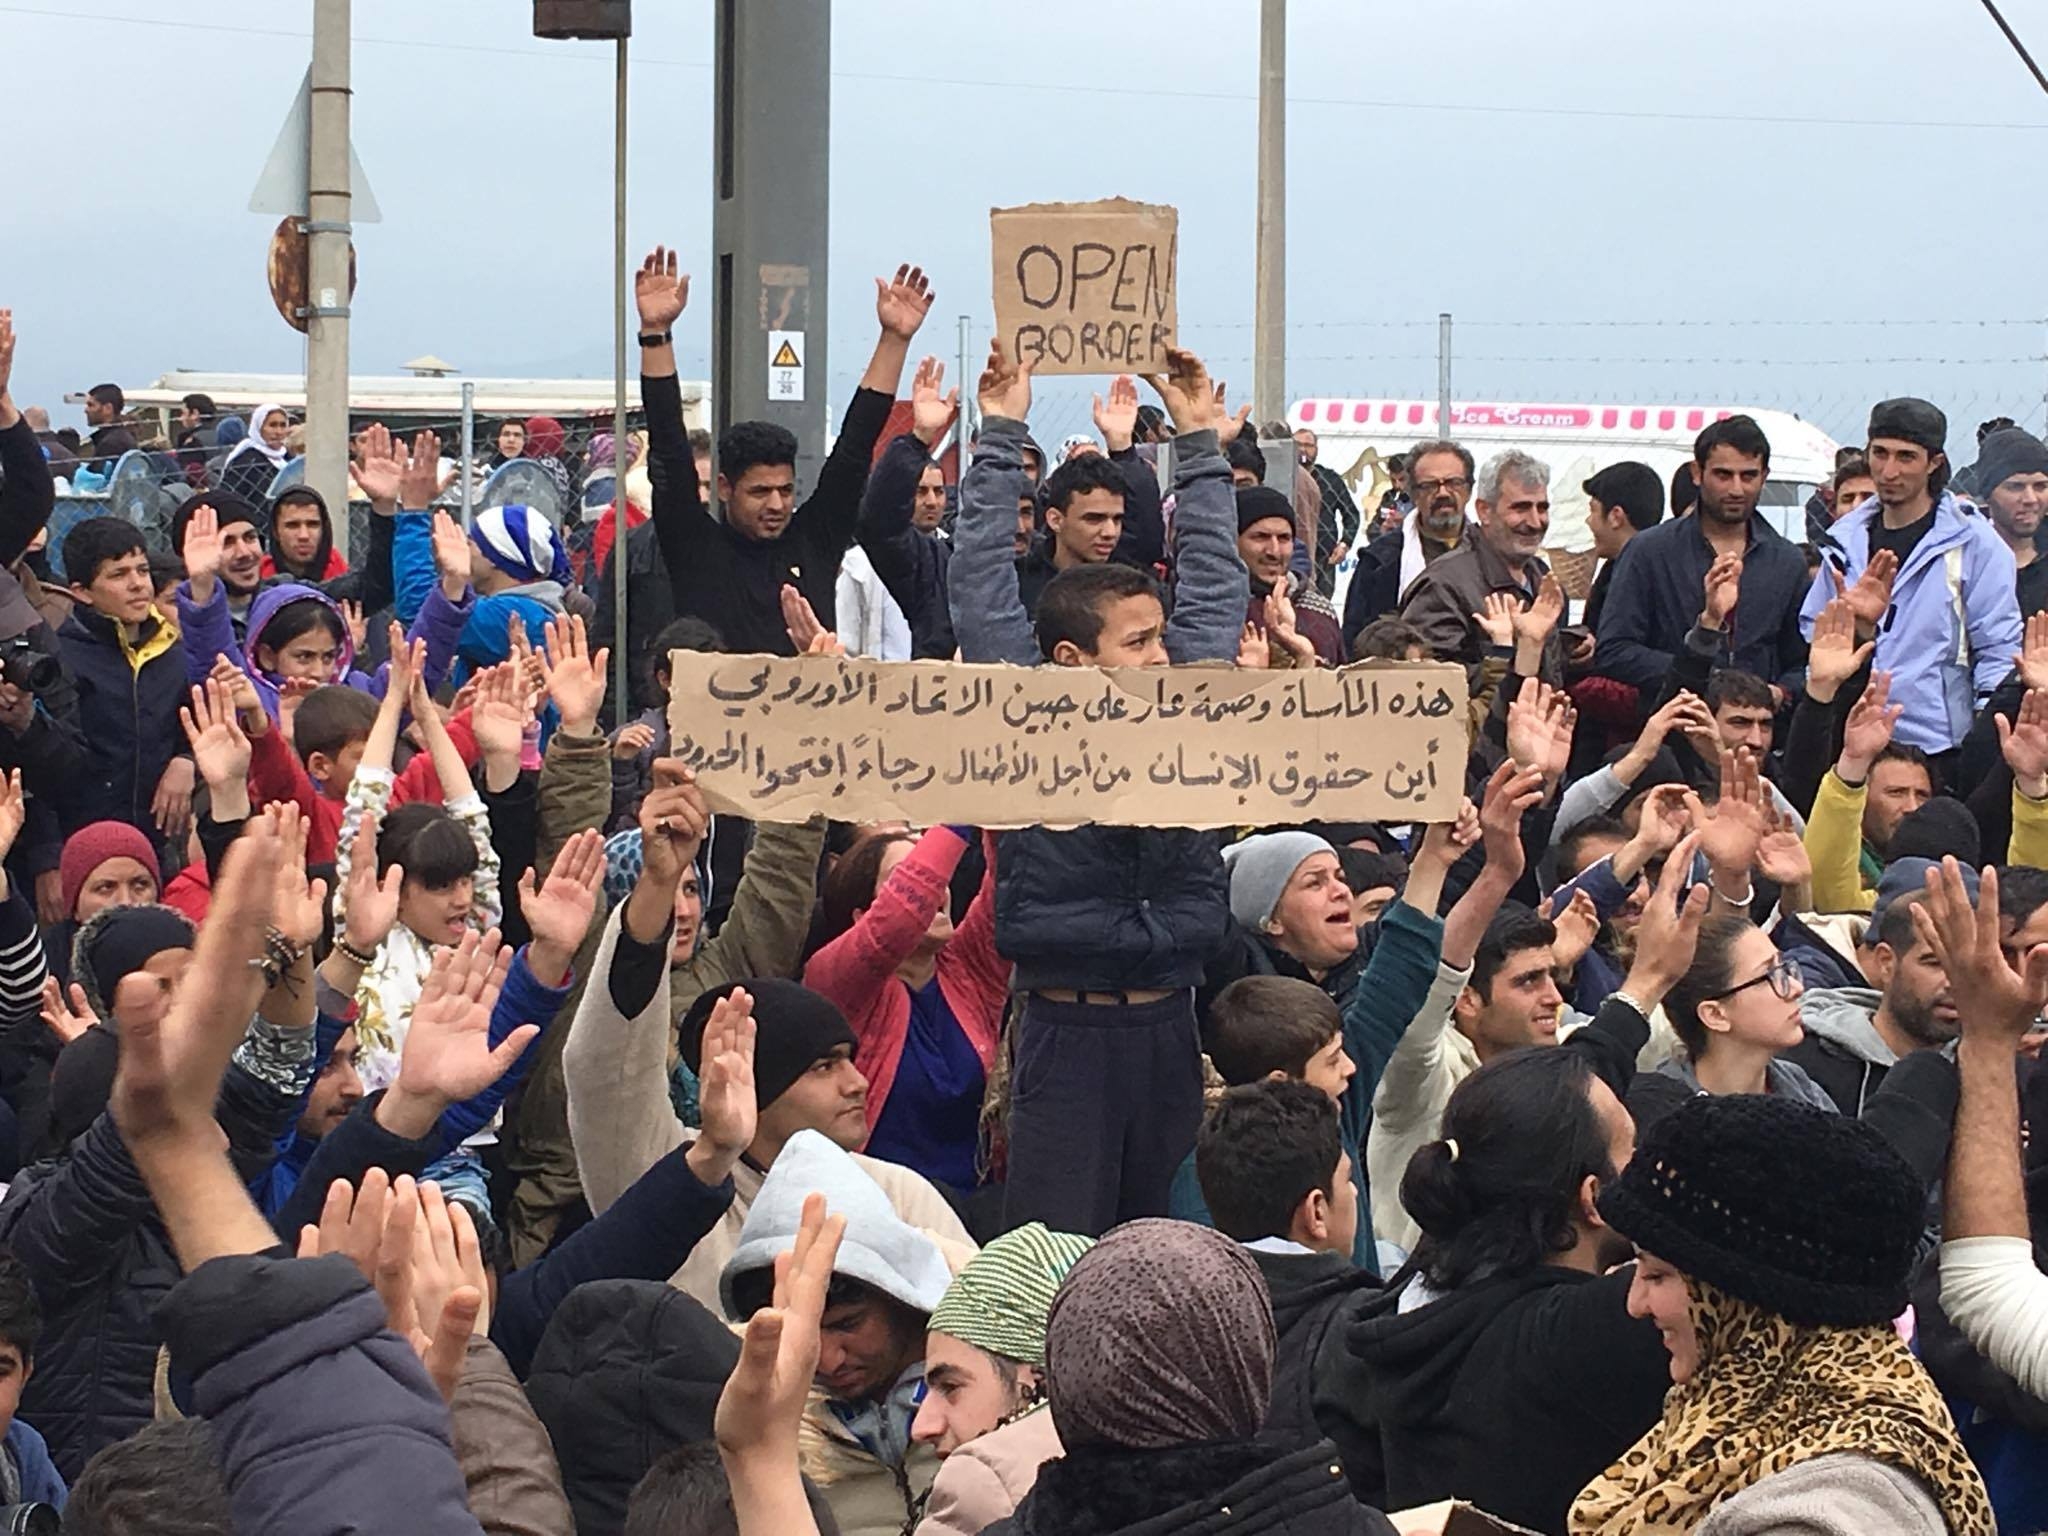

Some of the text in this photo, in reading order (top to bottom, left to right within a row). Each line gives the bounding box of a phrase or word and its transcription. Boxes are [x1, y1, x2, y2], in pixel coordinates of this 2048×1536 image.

[1017, 233, 1175, 321] OPEN
[1015, 320, 1172, 365] BORDER
[1451, 405, 1575, 425] Ice Cream
[708, 661, 1454, 734] هذه المأساة وصمة عار على جبين الاتحاد الأوروبي
[673, 729, 748, 774] الحدود
[750, 736, 848, 798] إفتحوا
[943, 739, 1038, 786] الأطفال
[1038, 738, 1092, 796] أجل
[1093, 752, 1132, 793] من
[1148, 742, 1261, 805] الإنسان
[1268, 750, 1373, 807] حقوق
[1384, 737, 1439, 802] أين
